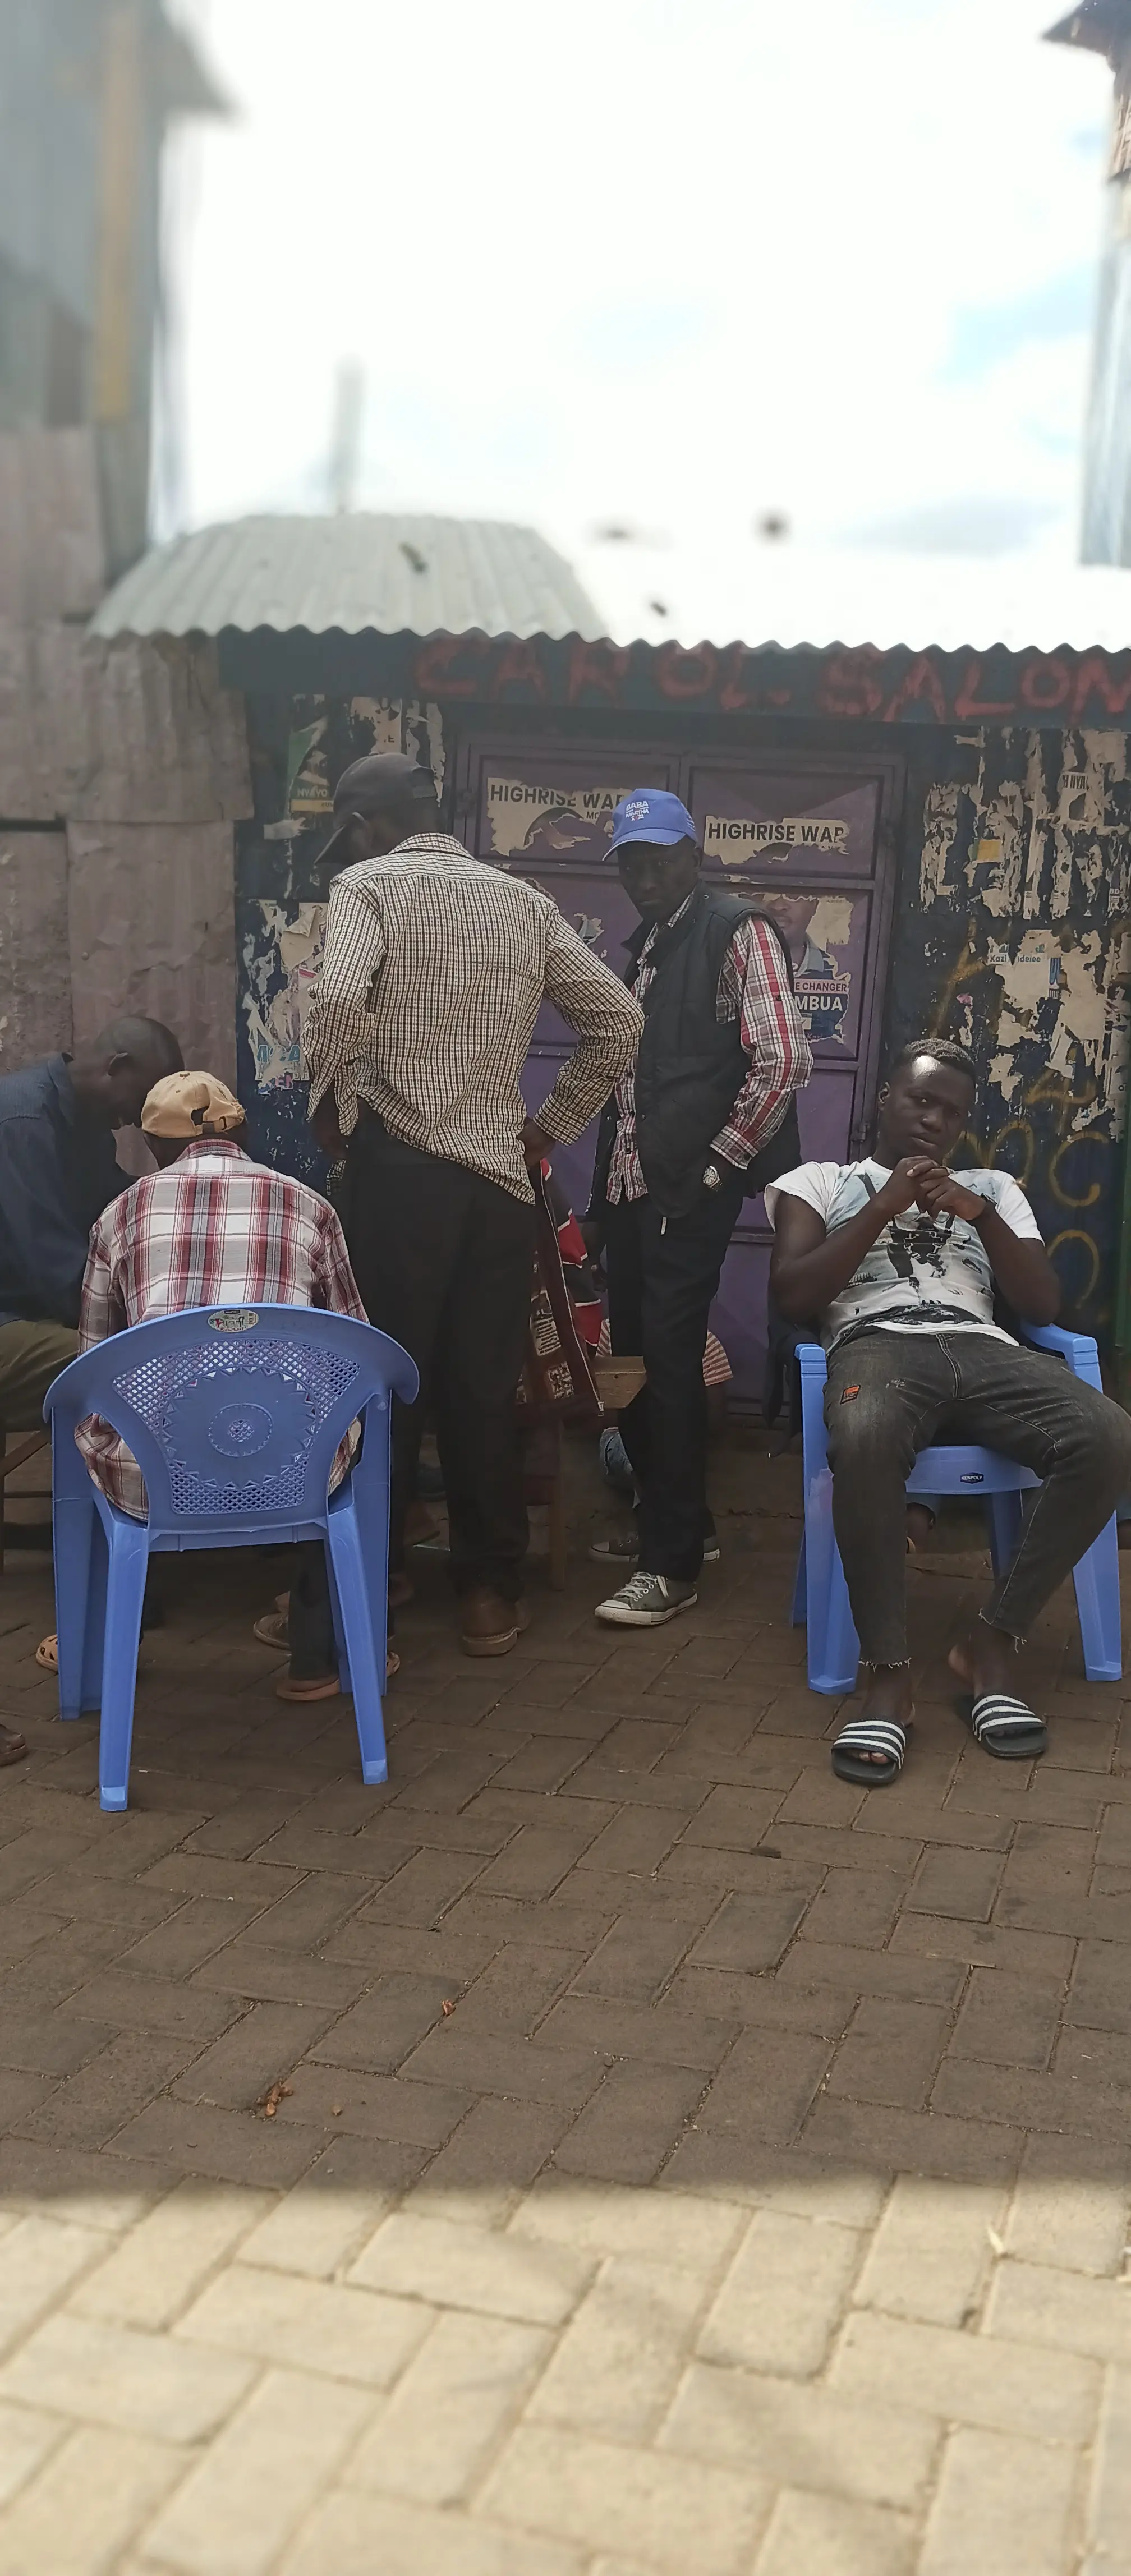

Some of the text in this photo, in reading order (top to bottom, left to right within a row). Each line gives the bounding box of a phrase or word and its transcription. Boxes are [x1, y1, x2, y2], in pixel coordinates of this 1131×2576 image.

[815, 643, 1131, 726] SALON
[297, 788, 328, 797] NYYO
[490, 785, 576, 807] HIGHRISE
[626, 809, 649, 818] MARTHA
[709, 823, 795, 841] HIGHRISE
[796, 982, 847, 991] E CHANGER
[794, 996, 843, 1011] MBUA
